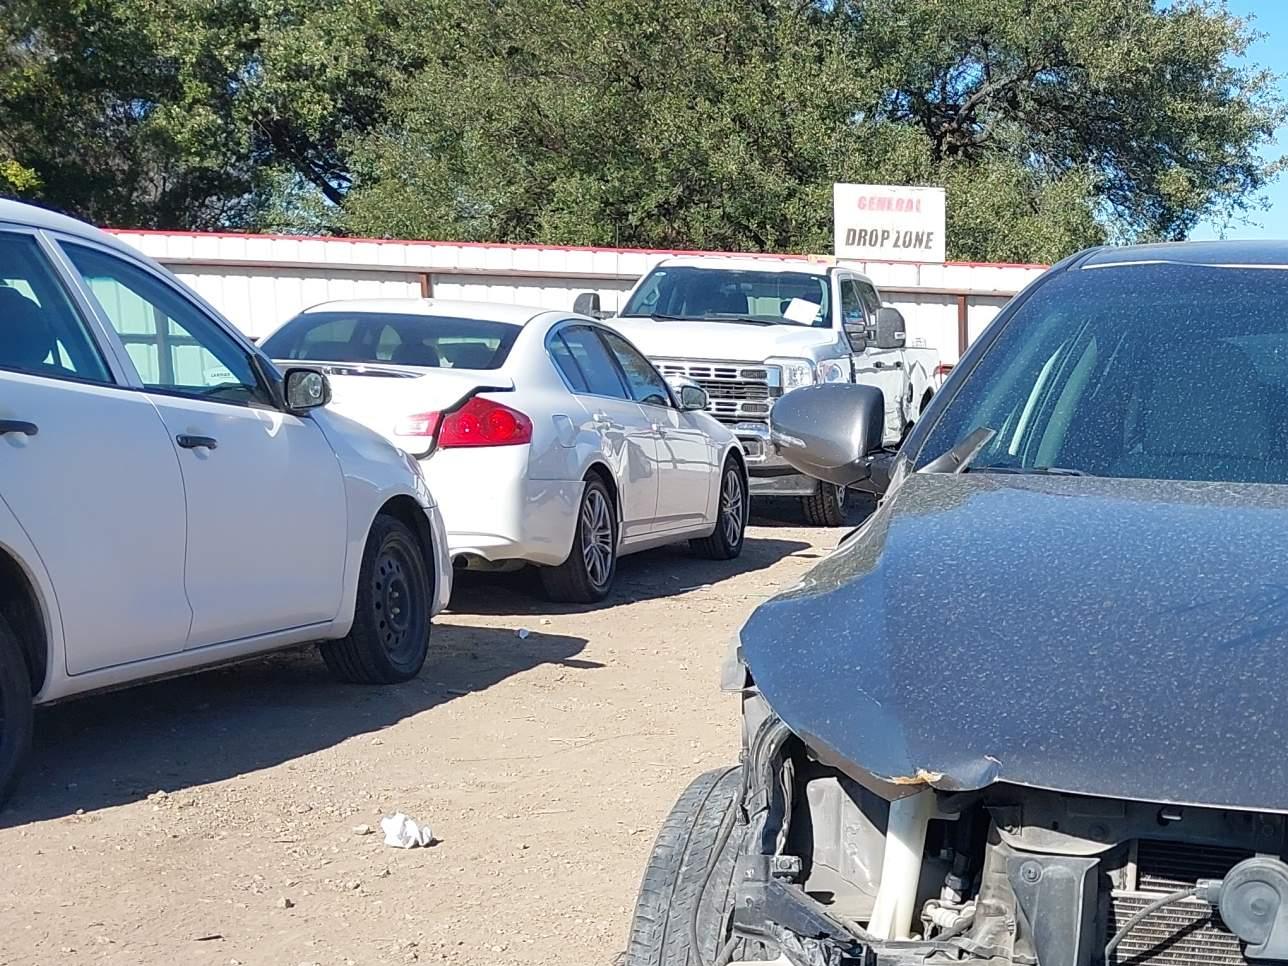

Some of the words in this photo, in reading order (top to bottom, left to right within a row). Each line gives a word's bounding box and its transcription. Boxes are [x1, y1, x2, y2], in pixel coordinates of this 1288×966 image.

[857, 195, 922, 213] GENERAL
[845, 228, 890, 248] DROP
[892, 230, 934, 250] ZONE
